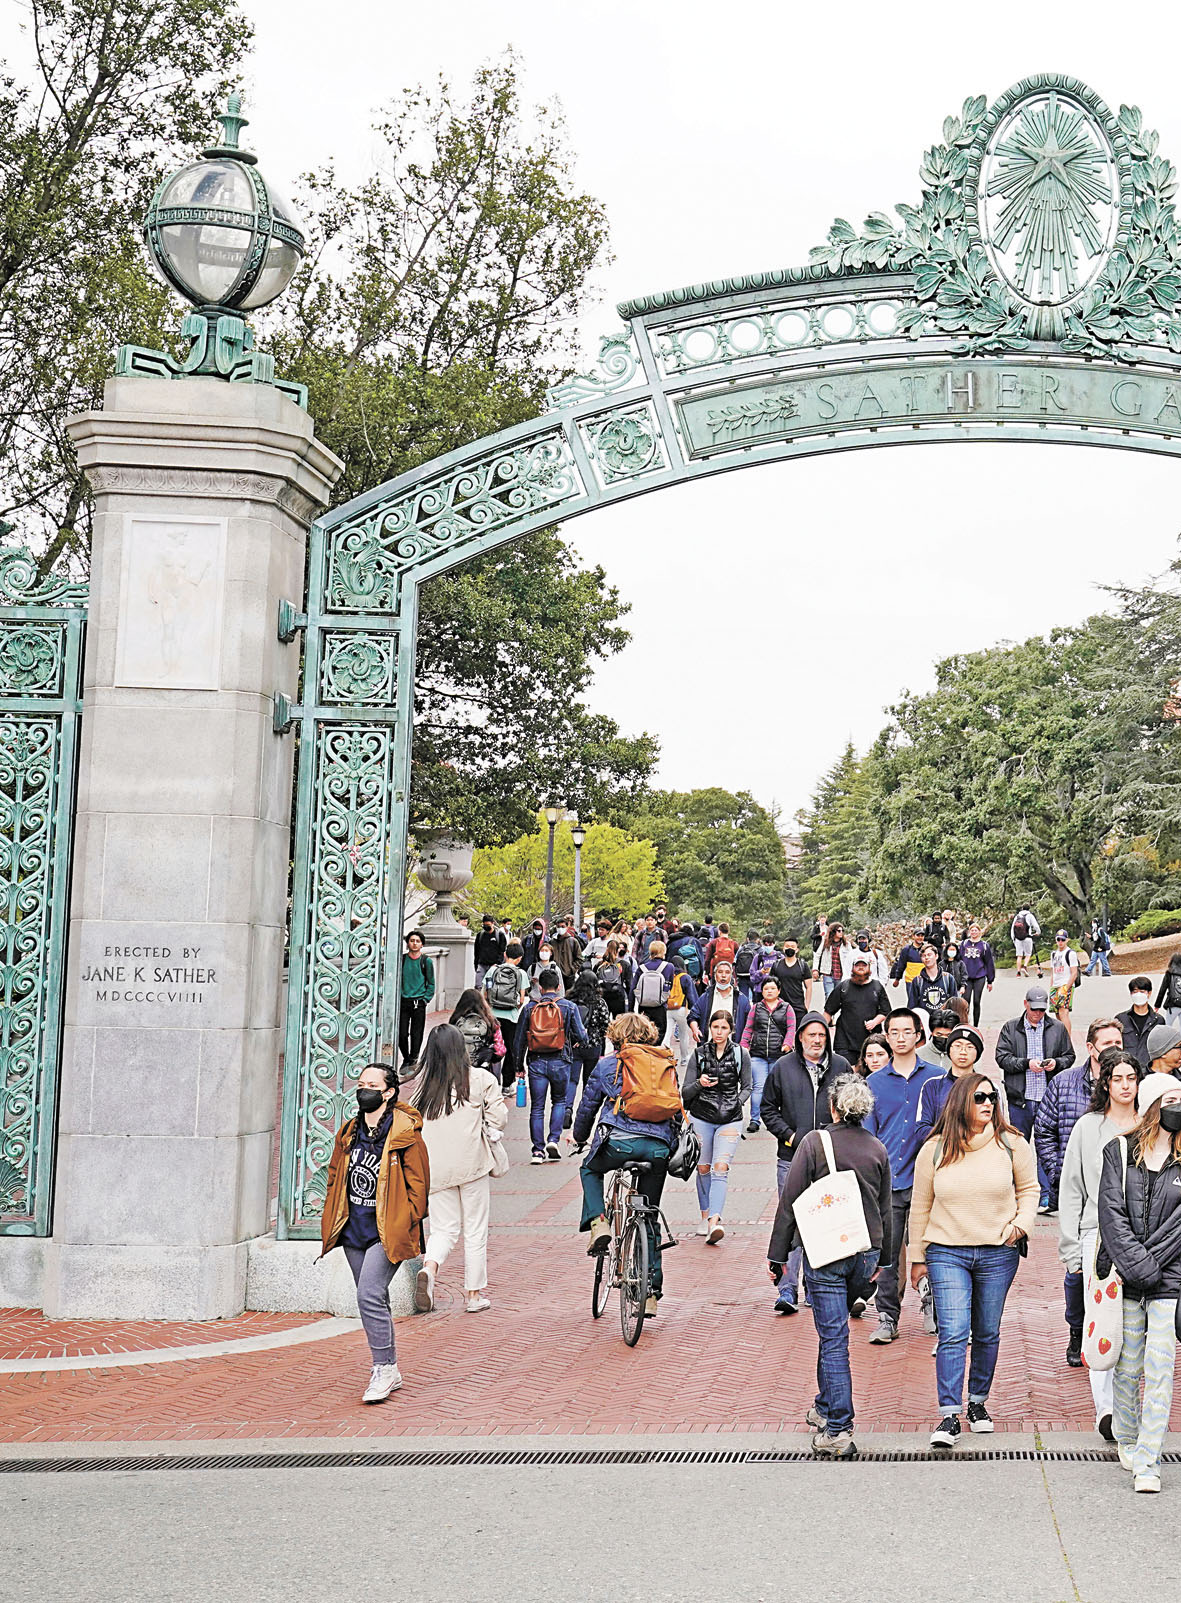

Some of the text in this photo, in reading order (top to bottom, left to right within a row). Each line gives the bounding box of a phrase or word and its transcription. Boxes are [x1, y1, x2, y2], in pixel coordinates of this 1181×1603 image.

[1027, 197, 1072, 211] FIAT LUX
[816, 371, 1068, 420] SATHER
[104, 946, 200, 959] ERECTED BY
[82, 966, 217, 984] JANE K SATHER
[361, 1151, 382, 1178] YOR
